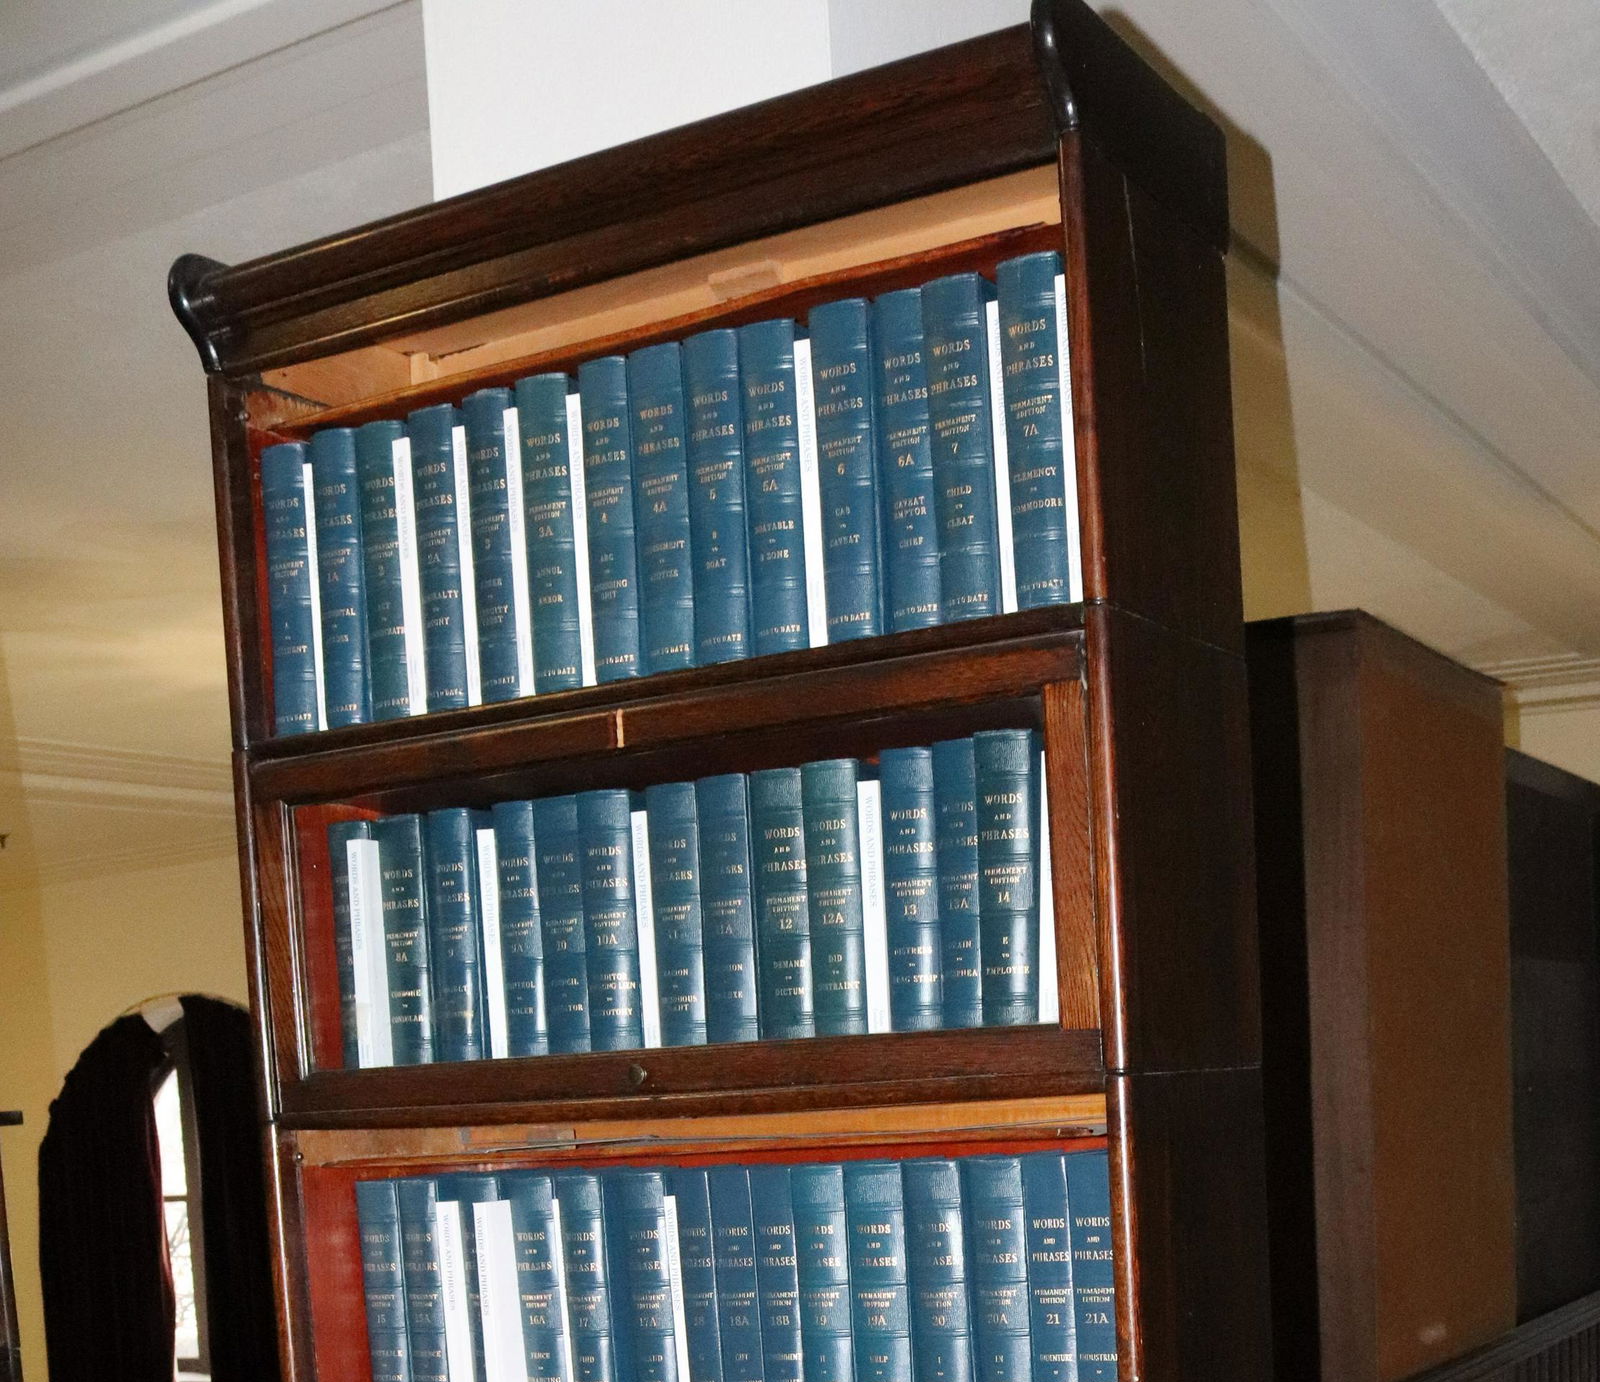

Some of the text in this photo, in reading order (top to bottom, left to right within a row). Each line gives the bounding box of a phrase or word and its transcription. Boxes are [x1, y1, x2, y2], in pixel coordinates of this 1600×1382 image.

[1008, 319, 1046, 338] WORDS
[933, 340, 970, 357] WORDS
[1019, 342, 1035, 351] AND
[884, 353, 920, 369] WORDS
[942, 362, 959, 371] AND
[1006, 355, 1053, 376] PHRASES
[820, 363, 856, 379] WORDS
[894, 376, 910, 384] AND
[931, 375, 977, 395] PHRASES
[749, 381, 785, 397] WORDS
[693, 391, 727, 407] WORDS
[1010, 395, 1052, 411] PERMANENT
[640, 405, 672, 419] WORDS
[758, 403, 774, 411] AND
[818, 397, 863, 416] PHRASES
[1016, 406, 1046, 420] EDITION
[588, 418, 619, 431] WORDS
[748, 415, 791, 433] PHRASES
[935, 414, 976, 430] PERMANENT
[692, 424, 734, 441] PHRASES
[889, 426, 927, 440] PERMANENT
[941, 424, 969, 437] EDITION
[1023, 424, 1039, 437] 7A
[527, 433, 560, 447] WORDS
[639, 437, 679, 454] PHRASES
[822, 436, 862, 451] PERMANENT
[893, 437, 920, 448] EDITION
[829, 447, 855, 458] EDITION
[952, 443, 958, 453] 7
[536, 453, 550, 461] AND
[898, 455, 914, 467] 6A
[838, 464, 844, 475] 6
[1013, 467, 1056, 483] CLEMENCY
[763, 479, 778, 491] 5A
[946, 485, 971, 496] CHILD
[529, 502, 566, 514] PERMANENT
[653, 501, 667, 513] 4A
[1013, 498, 1063, 515] COMMODORE
[601, 513, 608, 523] 4
[539, 526, 553, 537] 3A
[985, 793, 1022, 806] WORDS
[891, 808, 927, 820] WORDS
[813, 819, 846, 832] WORDS
[765, 827, 799, 839] WORDS
[982, 829, 1029, 840] PHRASES
[588, 846, 621, 856] WORDS
[865, 796, 877, 907] WORDS AND PHRASES
[889, 842, 933, 854] PHRASES
[763, 860, 806, 871] PHRASES
[985, 867, 1028, 875] PERMANENT
[384, 869, 413, 880] WORDS
[892, 880, 932, 888] PERMANENT
[767, 896, 806, 904] PERMANENT
[999, 892, 1010, 903] 14
[384, 899, 419, 910] PHRASES
[904, 904, 917, 915] 13
[780, 919, 792, 929] 12
[823, 913, 844, 924] 12A
[598, 934, 617, 945] 10A
[396, 953, 407, 962] 8A
[987, 966, 1029, 975] EMPLOYEE
[775, 988, 804, 996] DICTUM
[1033, 1218, 1064, 1228] WORDS
[1076, 1217, 1109, 1227] WORDS
[760, 1226, 790, 1235] WORDS
[857, 1224, 891, 1234] WORDS
[516, 1232, 545, 1240] WORDS
[1033, 1252, 1070, 1261] PHRASES
[1075, 1250, 1113, 1260] PHRASES
[518, 1263, 551, 1271] PHRASES
[377, 1314, 385, 1323] 15
[529, 1315, 545, 1325] 16A
[730, 1316, 749, 1326] 18A
[771, 1315, 789, 1325] 18B
[868, 1315, 886, 1325] 19A
[933, 1316, 945, 1326] 20
[1047, 1314, 1059, 1324] 21
[1085, 1313, 1109, 1323] 21A
